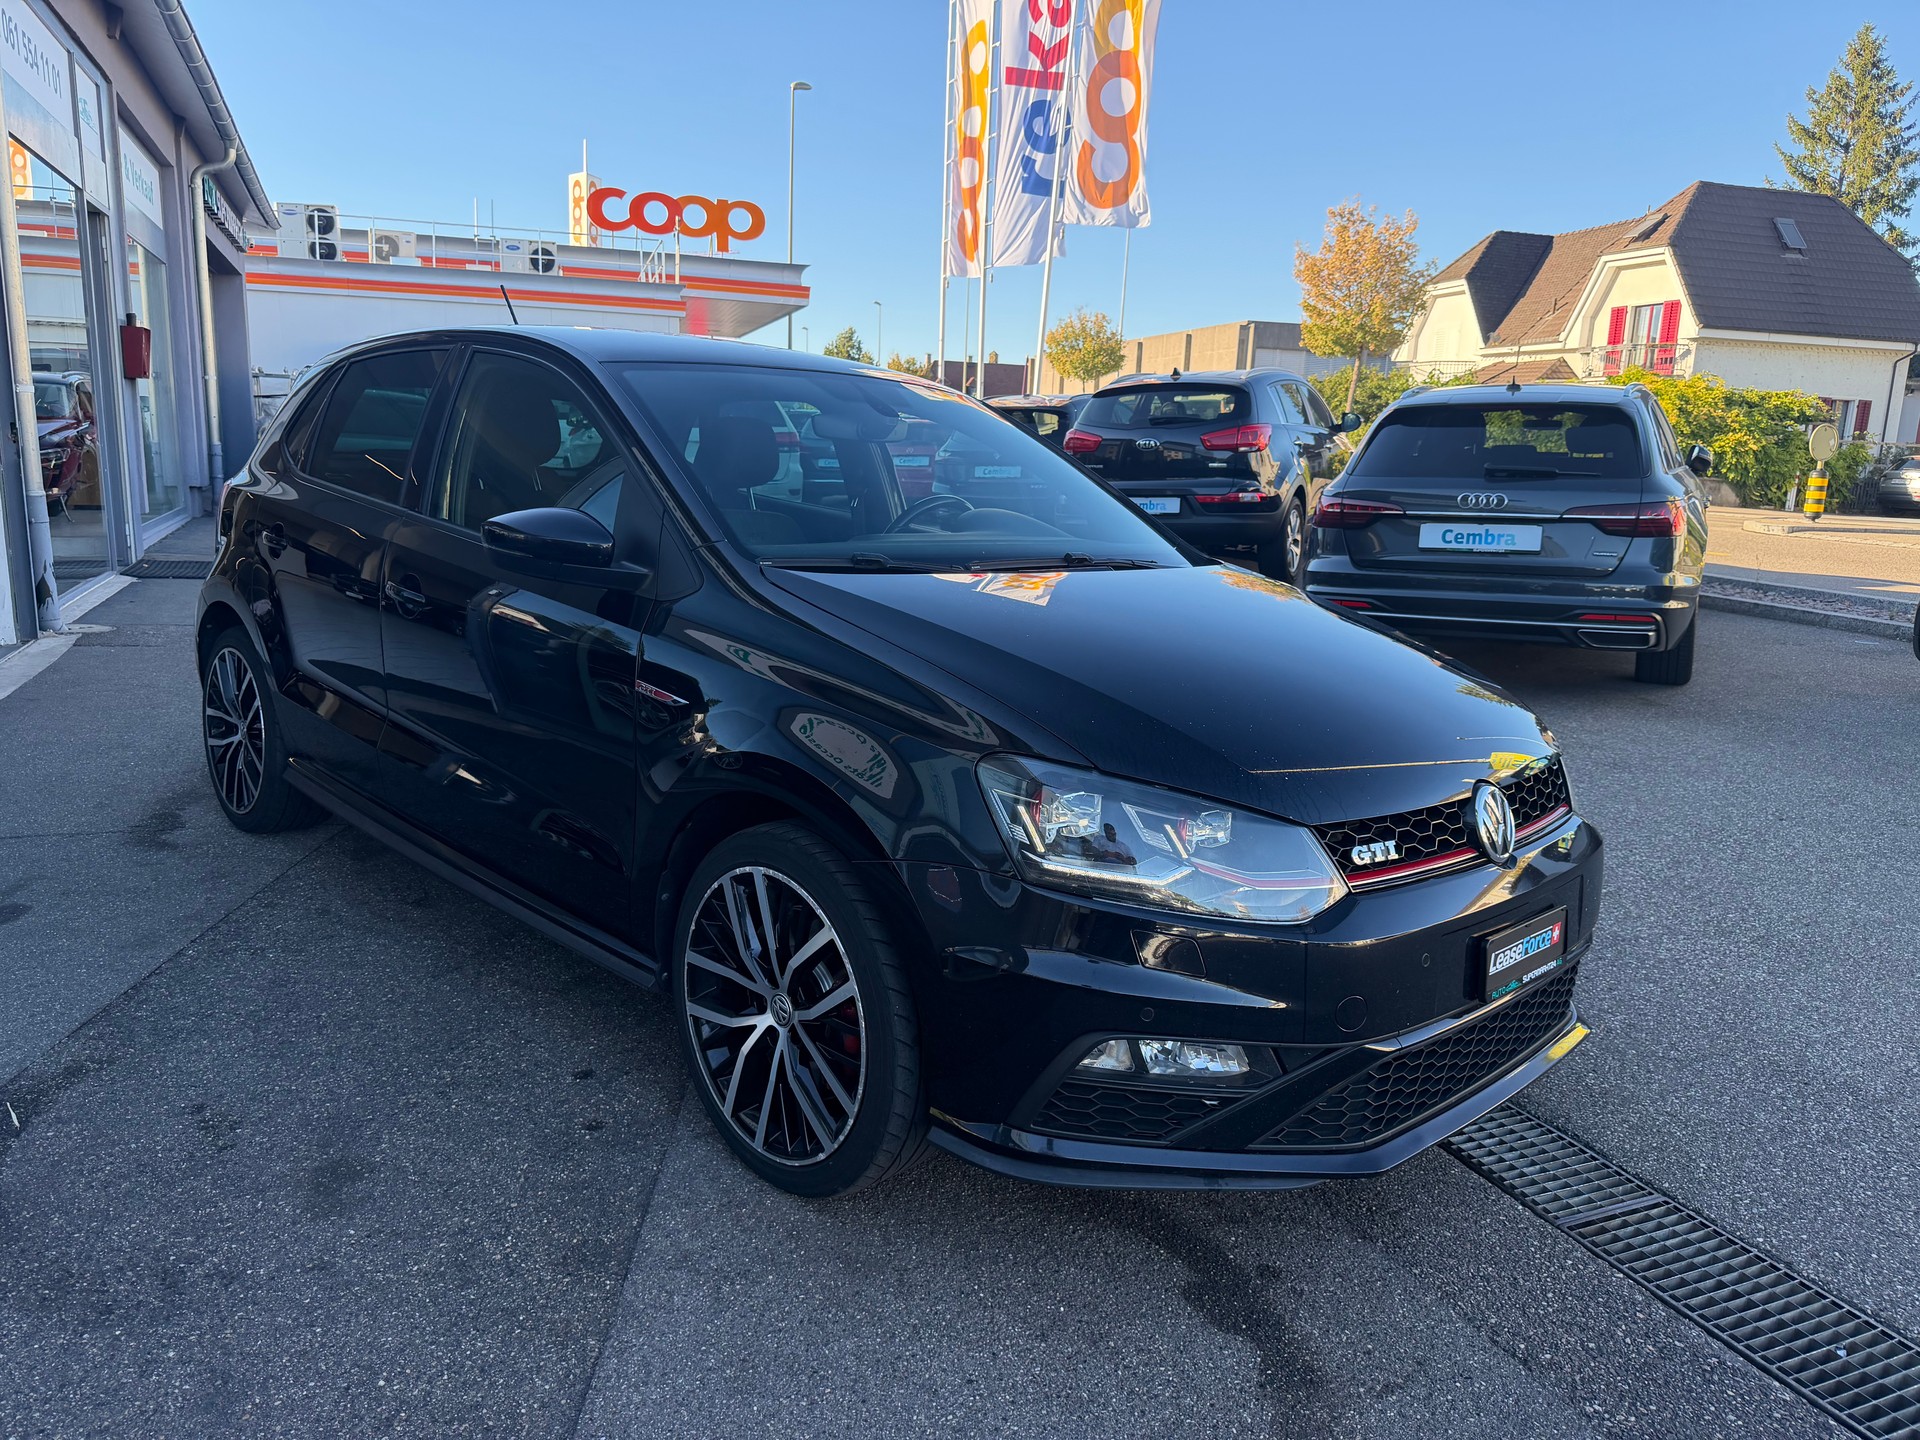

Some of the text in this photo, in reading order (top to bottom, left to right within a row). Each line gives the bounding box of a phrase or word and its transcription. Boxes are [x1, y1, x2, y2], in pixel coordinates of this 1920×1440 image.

[1, 8, 62, 99] 061 554 11 01
[587, 187, 766, 253] coop
[1441, 528, 1517, 546] Cembra
[1351, 840, 1399, 866] GTI
[1489, 929, 1552, 973] LeaseForce
